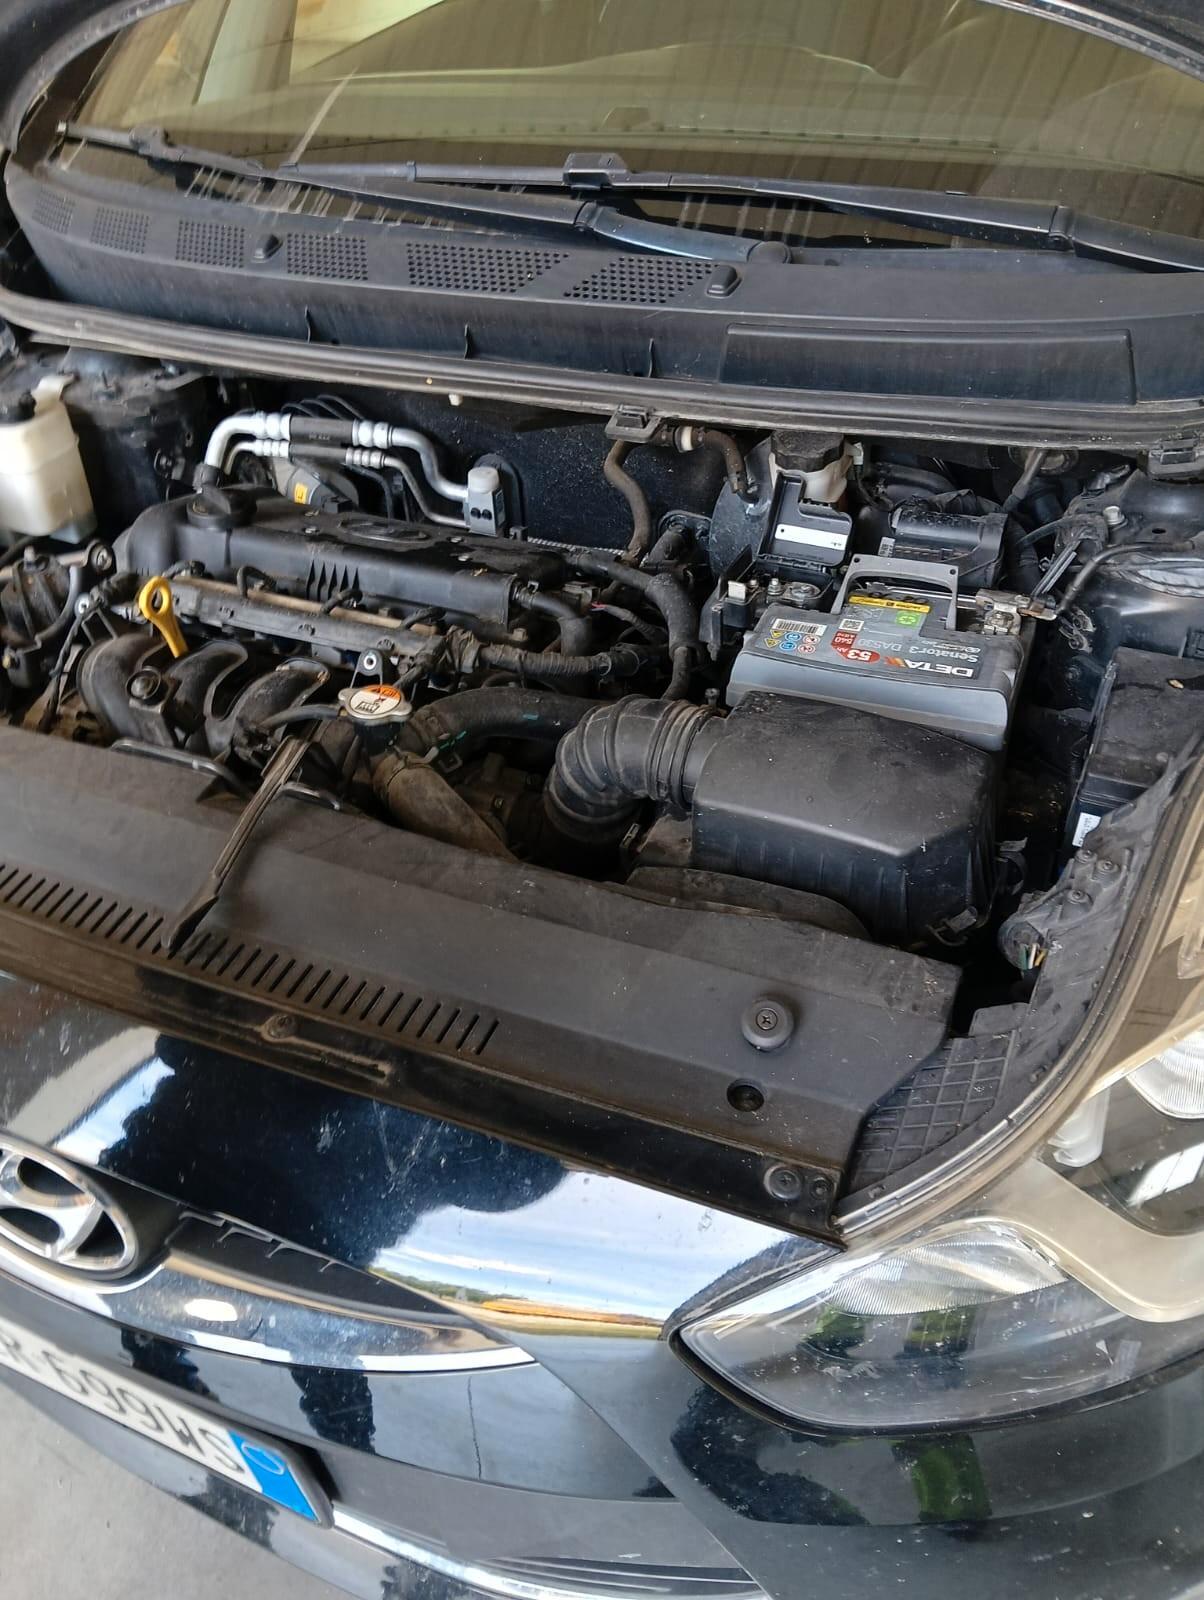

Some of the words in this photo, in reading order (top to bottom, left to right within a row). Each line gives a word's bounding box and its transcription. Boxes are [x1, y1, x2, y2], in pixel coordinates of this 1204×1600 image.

[857, 638, 902, 652] DA530
[847, 650, 872, 662] 53
[904, 659, 974, 678] DETA
